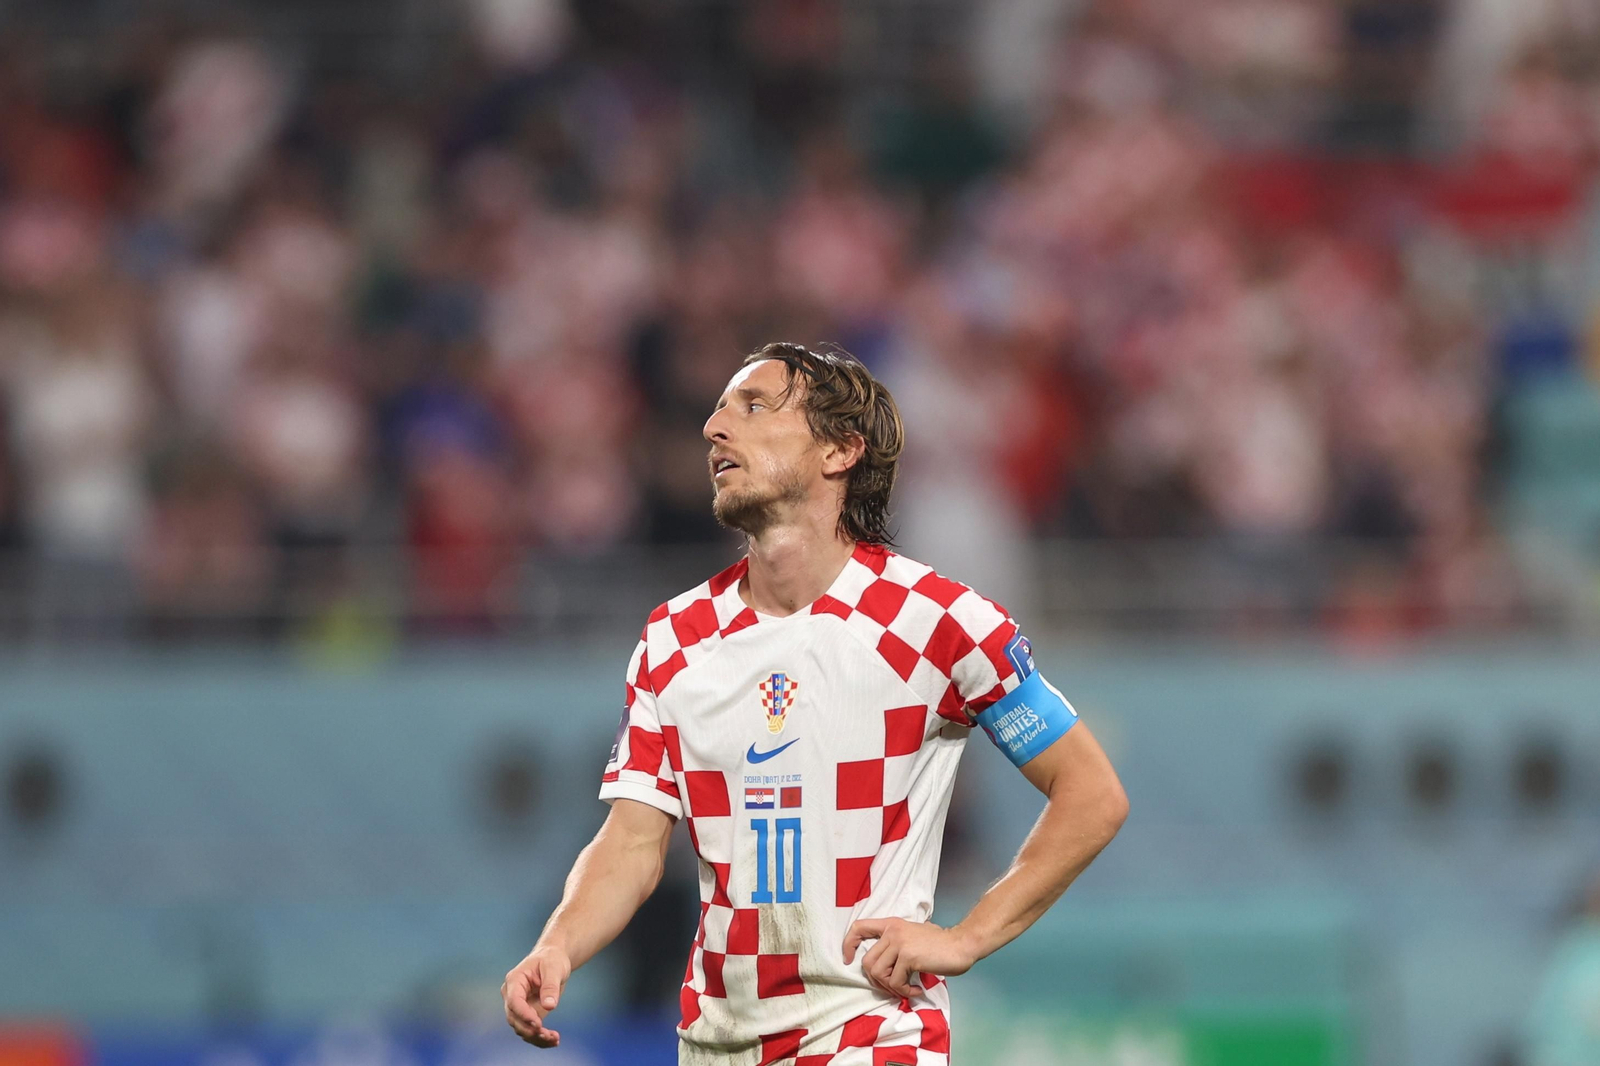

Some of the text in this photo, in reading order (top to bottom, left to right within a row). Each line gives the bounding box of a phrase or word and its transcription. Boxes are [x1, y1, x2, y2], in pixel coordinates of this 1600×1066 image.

[993, 702, 1030, 731] FOOTBALL
[999, 709, 1039, 742] UNITES
[1009, 718, 1048, 752] the World
[744, 775, 762, 783] DOHA
[751, 818, 802, 903] 10
